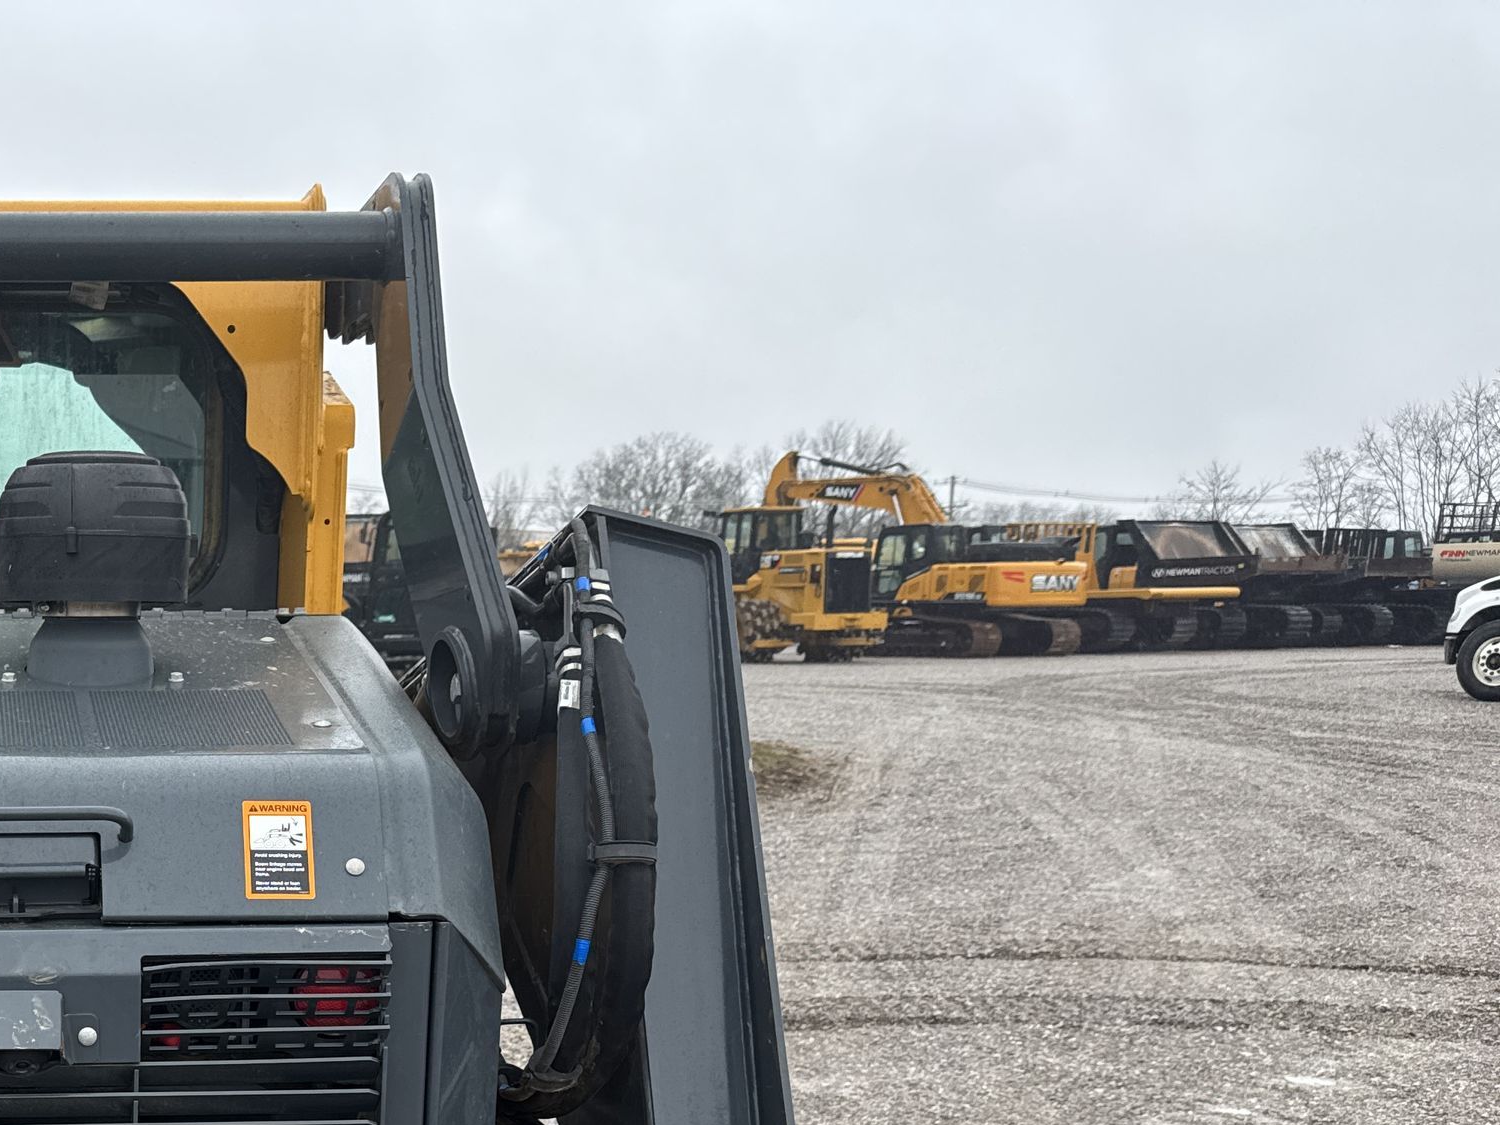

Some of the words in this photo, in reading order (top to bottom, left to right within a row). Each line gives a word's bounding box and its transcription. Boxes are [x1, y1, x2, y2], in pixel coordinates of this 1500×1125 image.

[824, 486, 857, 498] SANY
[1030, 574, 1080, 593] SANY
[259, 804, 307, 813] WARNING
